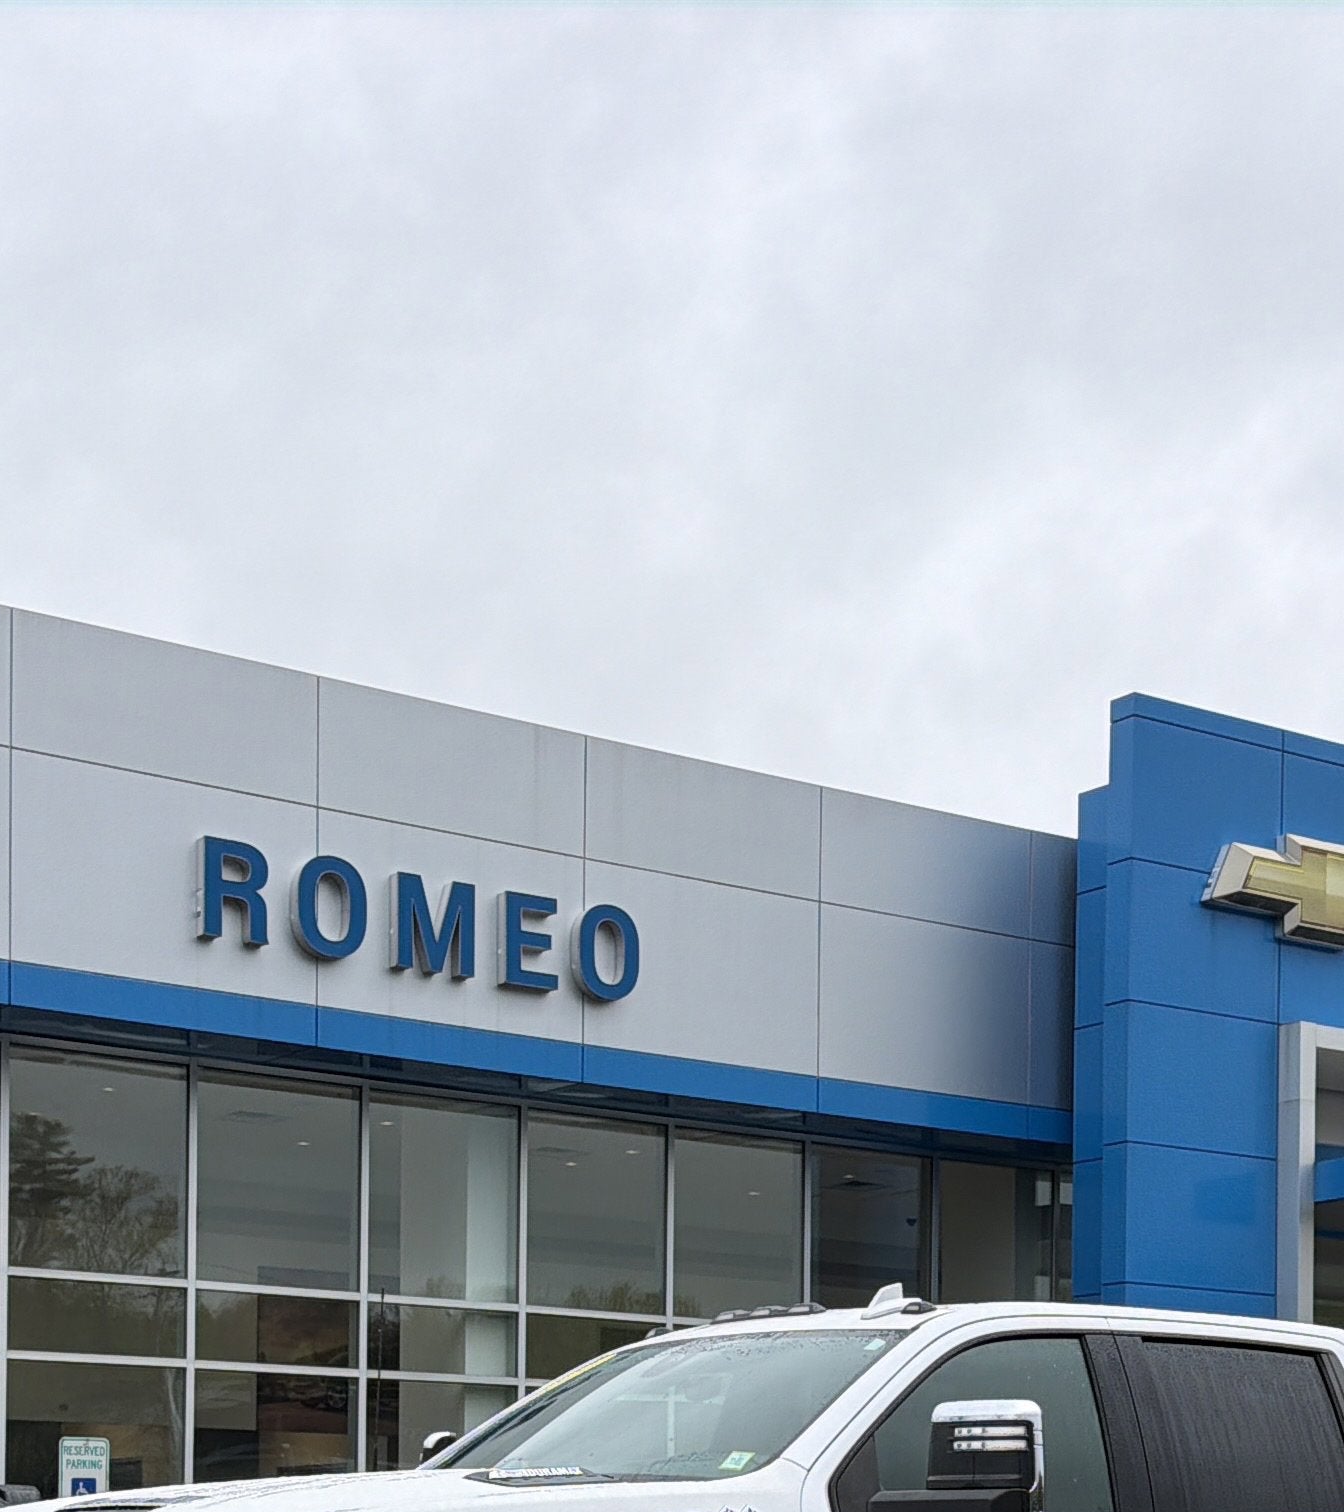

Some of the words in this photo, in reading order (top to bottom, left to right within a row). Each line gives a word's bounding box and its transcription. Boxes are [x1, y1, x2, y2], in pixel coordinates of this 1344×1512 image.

[197, 834, 640, 1002] ROMEO
[63, 1445, 106, 1457] RESERVED
[65, 1458, 103, 1470] PARKING
[525, 1466, 584, 1479] DURAMAX
